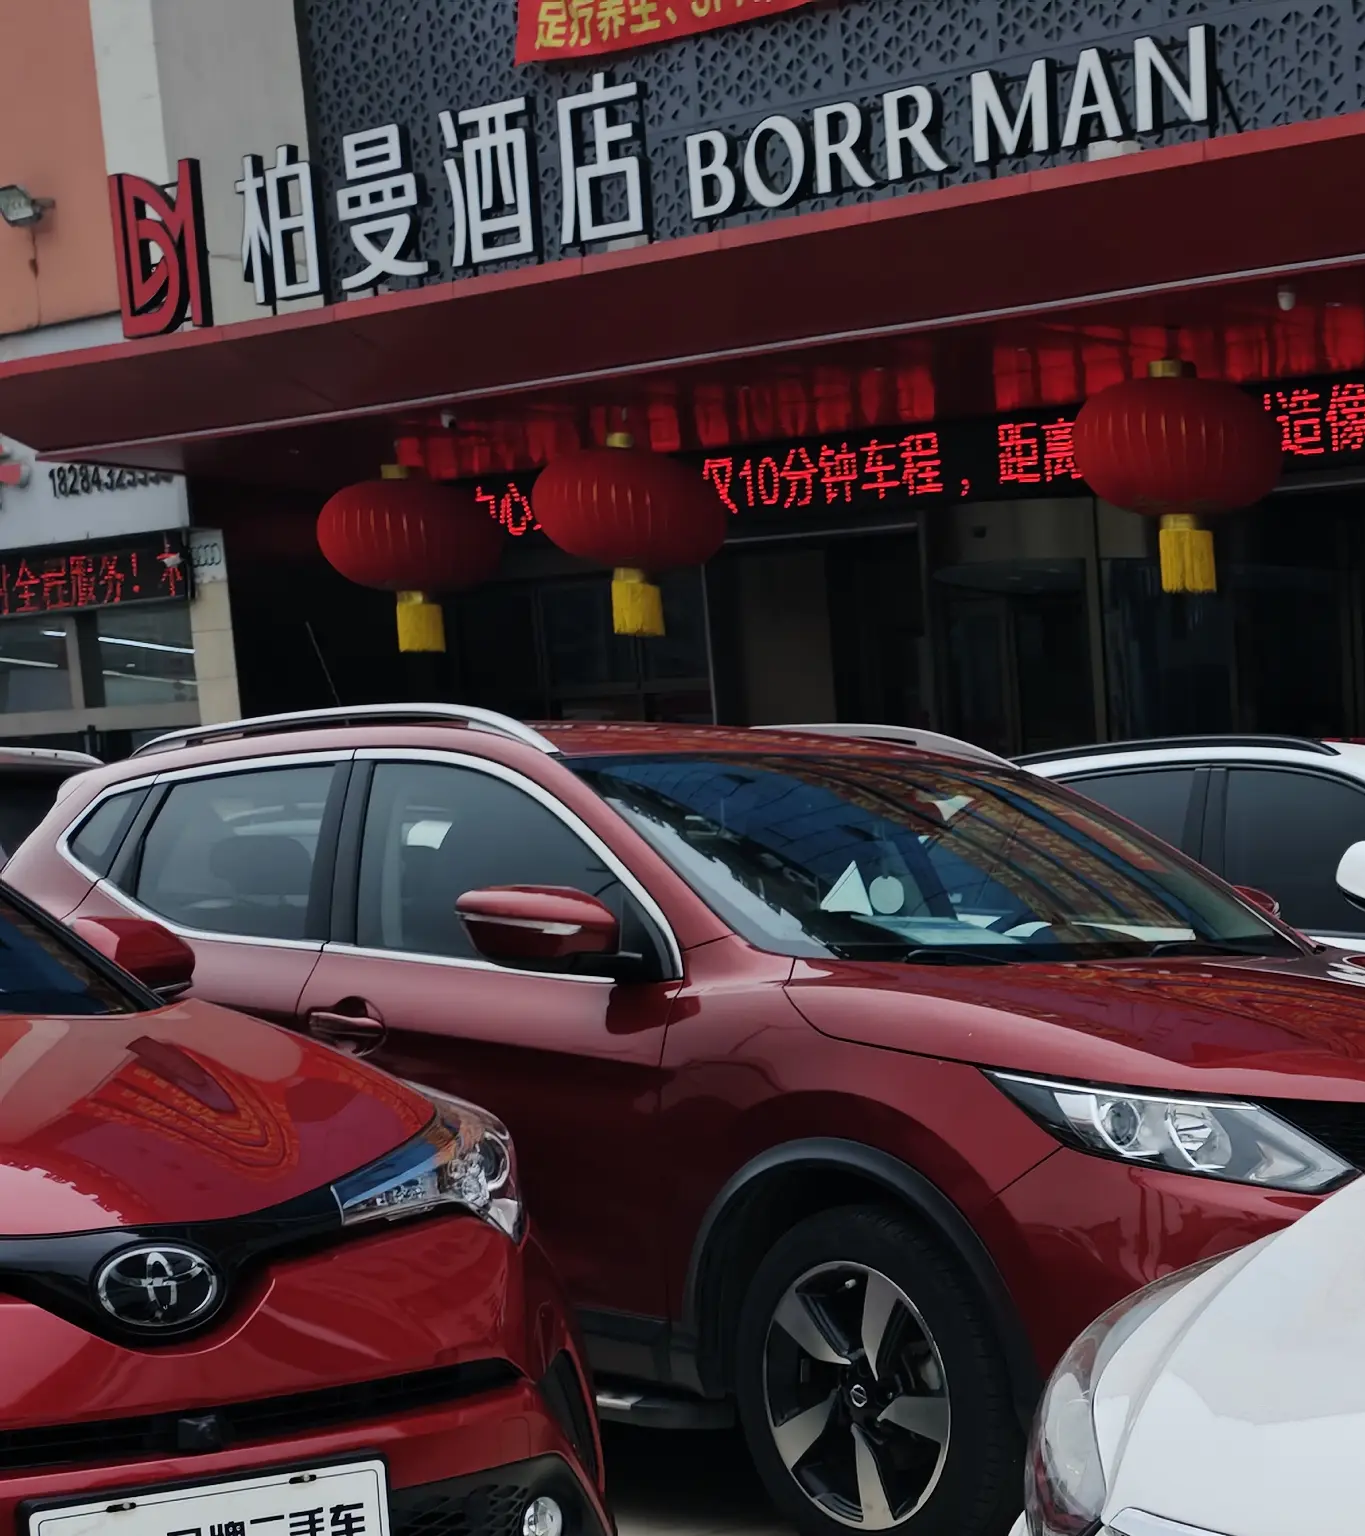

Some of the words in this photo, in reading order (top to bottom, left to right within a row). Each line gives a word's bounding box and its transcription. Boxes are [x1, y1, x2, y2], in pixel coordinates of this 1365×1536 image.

[235, 72, 645, 305] 柏曼酒店
[685, 84, 949, 220] BORR
[970, 24, 1208, 165] MAN
